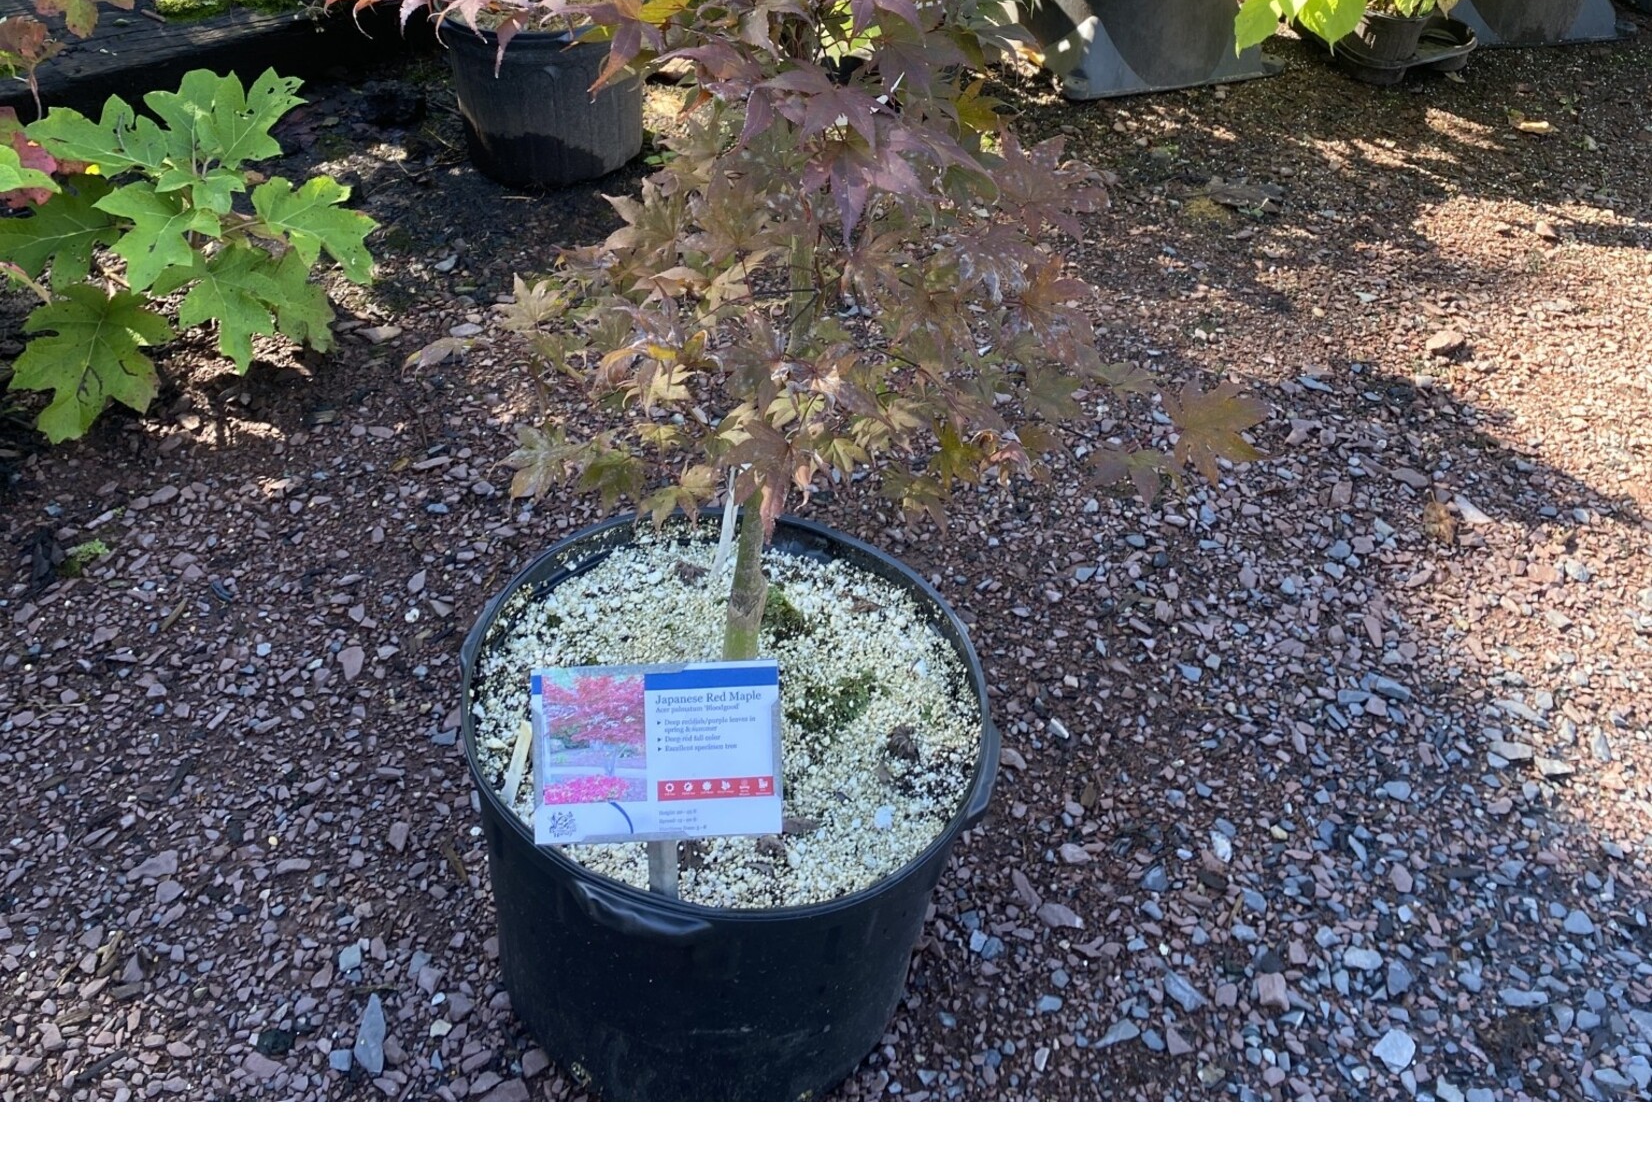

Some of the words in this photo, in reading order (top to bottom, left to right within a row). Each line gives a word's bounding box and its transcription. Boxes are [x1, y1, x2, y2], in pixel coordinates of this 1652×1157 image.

[655, 694, 703, 707] Japanese
[706, 692, 726, 703] Red
[729, 690, 762, 704] Maple
